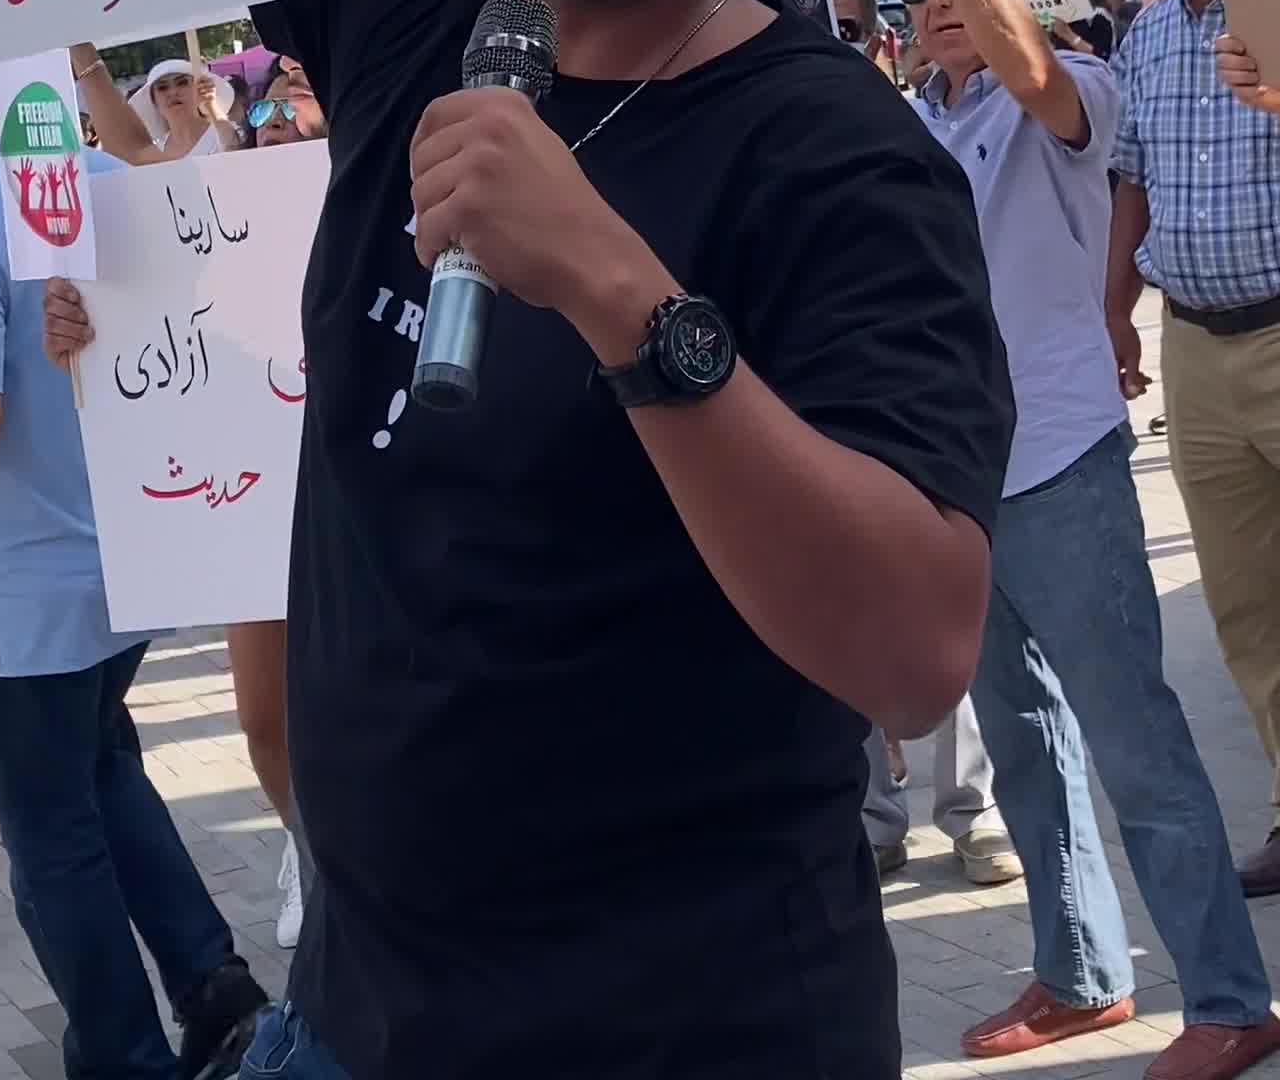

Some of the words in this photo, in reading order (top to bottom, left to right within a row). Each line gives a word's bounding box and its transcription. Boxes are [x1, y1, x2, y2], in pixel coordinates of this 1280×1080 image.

[166, 185, 248, 255] سارینا
[115, 303, 213, 401] آزادی
[141, 456, 260, 509] حدیث
